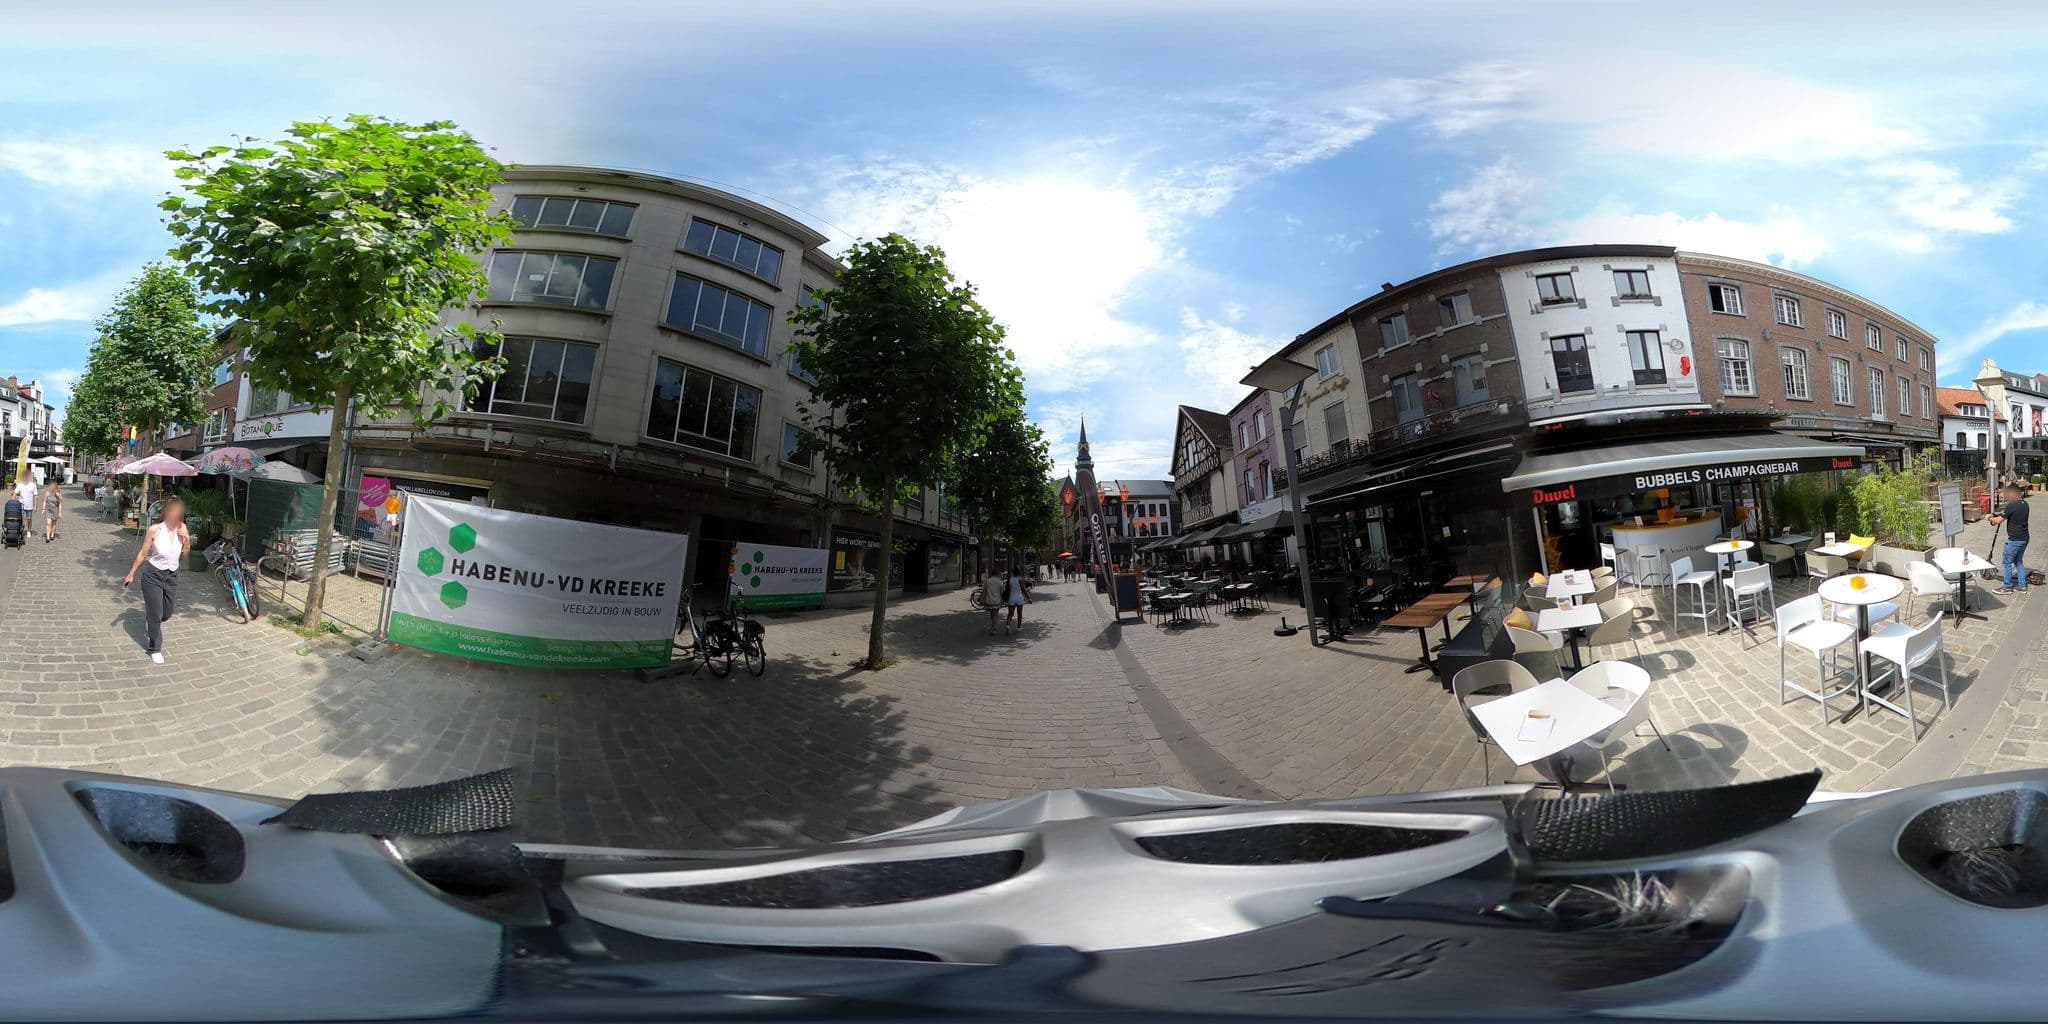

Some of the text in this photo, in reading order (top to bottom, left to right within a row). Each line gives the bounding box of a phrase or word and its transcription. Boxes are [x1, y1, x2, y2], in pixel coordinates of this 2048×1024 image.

[1832, 457, 1853, 468] Duvel
[1635, 461, 1799, 489] BUBBELS CHAMPAGNEBAR
[1532, 484, 1577, 504] Duvel
[589, 578, 666, 597] KREEKE
[562, 603, 662, 617] VEELZIJDIG IN BOUW
